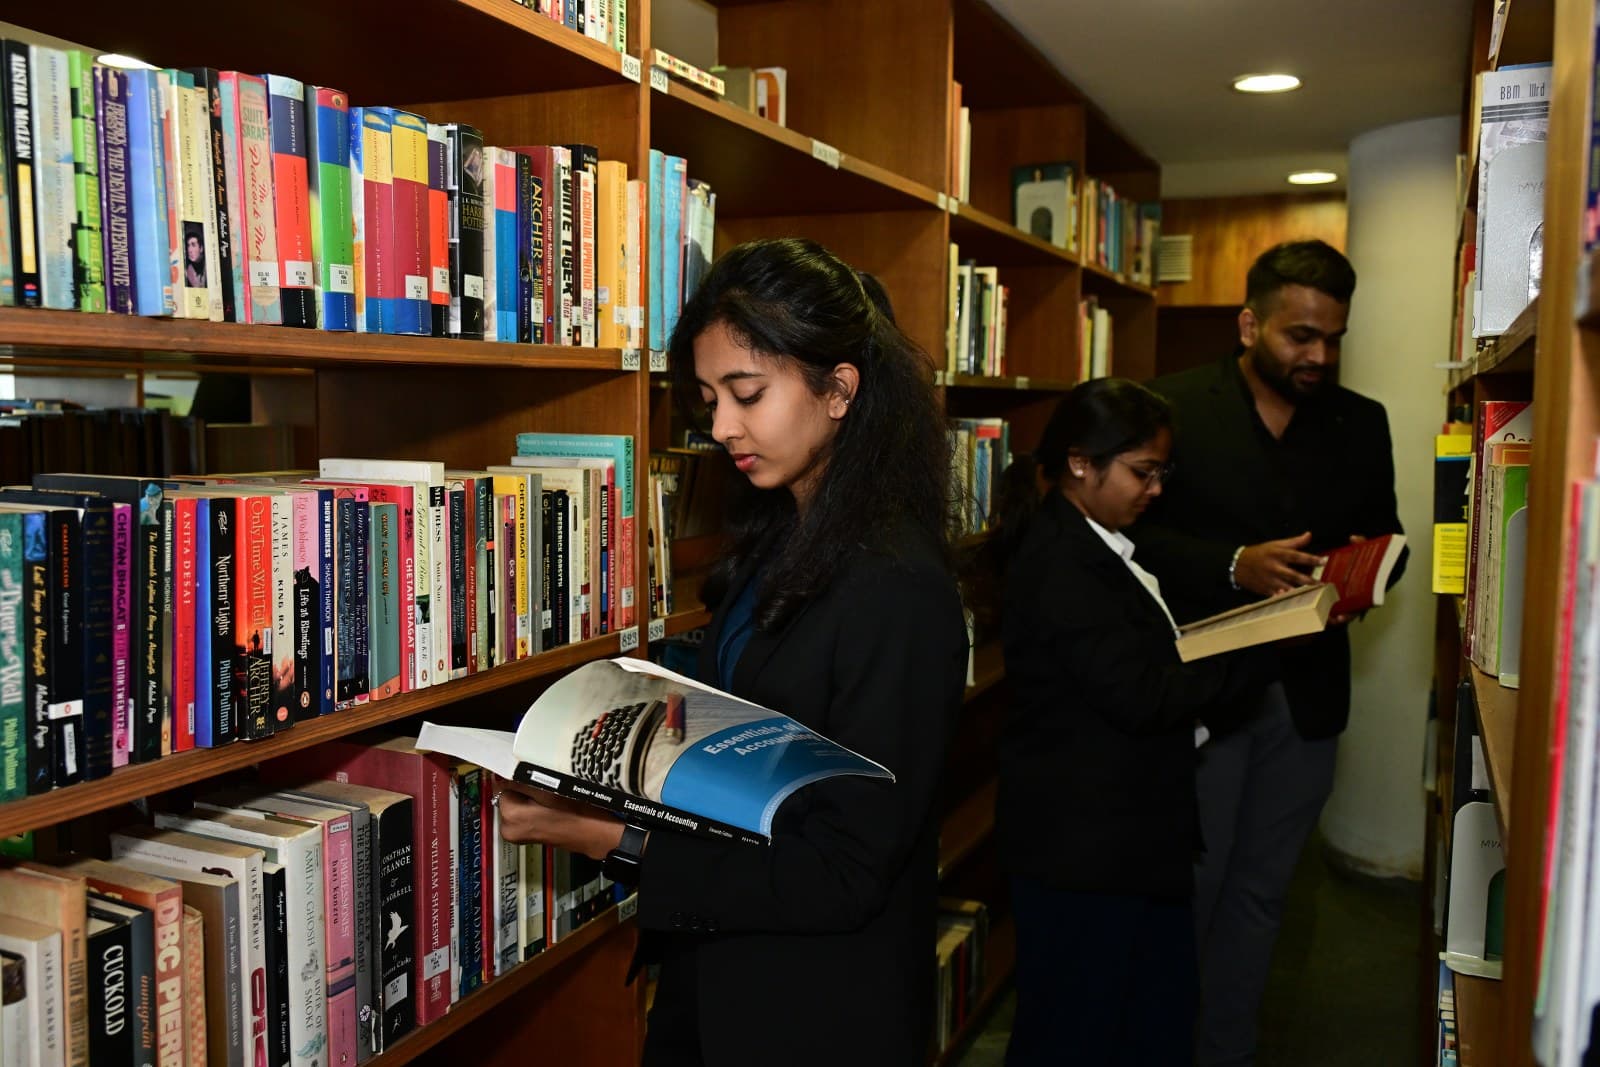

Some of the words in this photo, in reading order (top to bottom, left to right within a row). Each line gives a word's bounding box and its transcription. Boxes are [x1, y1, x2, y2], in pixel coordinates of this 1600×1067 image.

[11, 54, 29, 106] ALISTAIR
[83, 71, 92, 106] NICK
[1500, 84, 1521, 100] BBM
[84, 115, 97, 174] HORNBY
[108, 147, 123, 171] THE
[87, 180, 97, 217] HIGH
[109, 173, 125, 214] DEVIL'S
[248, 144, 262, 219] Peacock
[532, 183, 543, 259] ARCHER
[563, 178, 573, 231] WHITE
[583, 190, 592, 240] ACCIDENTAL
[111, 217, 130, 286] ALTERNATIVE
[561, 239, 573, 295] TIGER
[583, 242, 592, 291] APPRENTICE
[547, 273, 553, 286] do
[249, 500, 263, 536] Only
[323, 501, 331, 522] SHOW
[434, 487, 442, 543] MISTRESS
[116, 513, 127, 566] CHETAN
[183, 512, 191, 554] ANITA
[281, 517, 289, 558] JAMES
[33, 565, 46, 585] Last
[62, 557, 70, 588] DICKENS
[251, 539, 264, 576] Time
[435, 560, 443, 583] Anita
[116, 570, 127, 622] BHAGAT
[183, 560, 191, 605] DESAI
[216, 554, 231, 601] Northern
[252, 578, 265, 602] Will
[405, 558, 413, 601] CHETAN
[32, 589, 46, 613] Tango
[62, 592, 70, 608] Great
[252, 603, 265, 626] Tell
[299, 588, 310, 605] Life
[300, 607, 309, 618] at
[34, 615, 44, 625] in
[62, 610, 70, 645] Expectations
[217, 602, 230, 636] Lights
[299, 620, 311, 660] Blandings
[622, 631, 638, 648] 823
[1, 655, 23, 706] Well
[148, 680, 157, 705] Malcolm
[217, 660, 230, 689] Philip
[249, 656, 263, 715] ARCHER
[259, 660, 270, 705] JEFFREY
[35, 684, 48, 721] Malcolm
[146, 707, 157, 723] Pryce
[219, 692, 231, 735] Pullman
[1, 718, 17, 748] Philip
[35, 724, 47, 749] Pryce
[703, 725, 783, 755] Essentials
[4, 749, 20, 791] Pullman
[595, 790, 612, 803] Anthony
[623, 799, 657, 816] Essentials
[656, 810, 664, 818] of
[664, 811, 699, 830] Accounting
[331, 860, 339, 884] hari
[357, 850, 365, 889] LADIES
[379, 855, 411, 879] STRANGE
[382, 845, 411, 865] ONATHAN
[430, 837, 439, 889] WILLIAM
[473, 818, 481, 899] DOUGLAS
[250, 867, 258, 900] VIKAS
[305, 850, 315, 898] AMITAV
[306, 902, 316, 947] GHOSH
[333, 887, 341, 925] kunzru
[357, 902, 365, 938] GRACE
[431, 892, 440, 952] SHAKESPEA
[156, 897, 181, 972] DBC
[229, 925, 237, 943] Fine
[252, 906, 260, 951] SWARUP
[473, 906, 481, 962] ADAMS
[44, 952, 54, 991] VIKAS
[229, 945, 237, 974] Family
[358, 939, 366, 973] ADIEU
[103, 945, 125, 1035] CUCKOLD
[45, 997, 55, 1051] SWARUP
[158, 975, 183, 1067] PIERR
[304, 989, 313, 1031] SMOKE
[315, 1017, 322, 1029] OF
